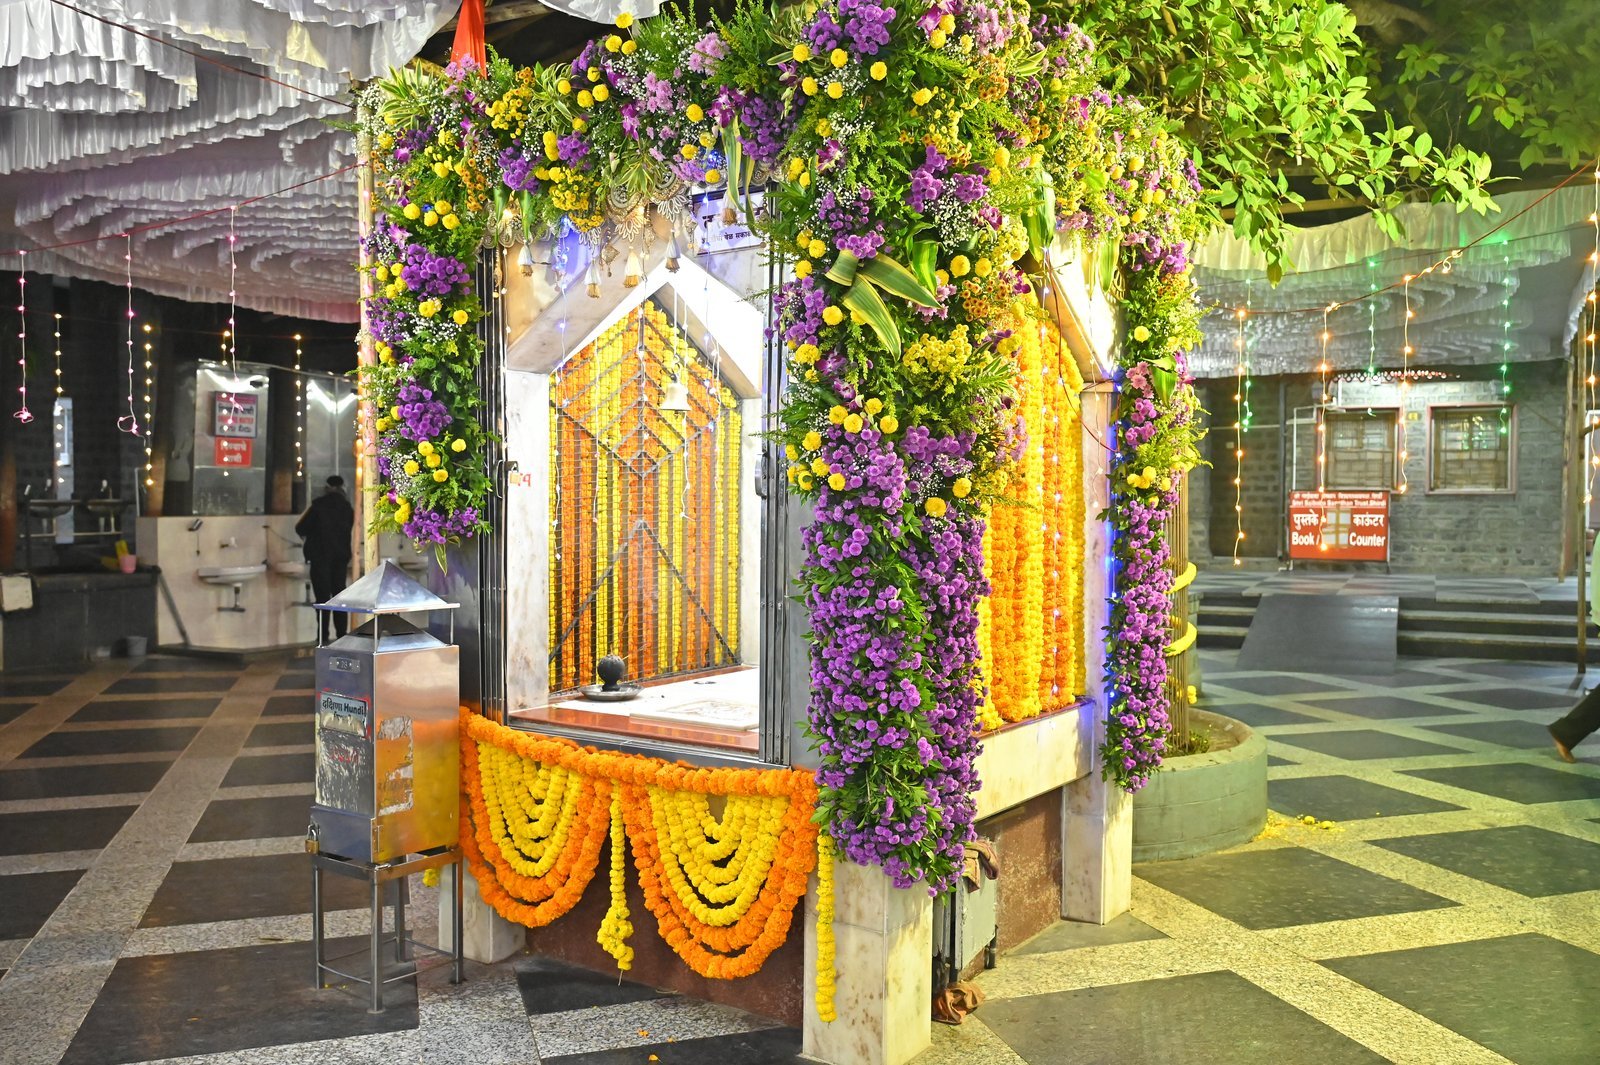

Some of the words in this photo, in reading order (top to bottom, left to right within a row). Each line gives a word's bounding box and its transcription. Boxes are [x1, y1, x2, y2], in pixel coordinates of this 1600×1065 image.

[1293, 509, 1319, 530] पुस्तके
[1291, 532, 1314, 545] Book
[1349, 532, 1386, 547] Counter
[323, 697, 343, 711] दक्षिणा
[344, 702, 364, 716] Hundi
